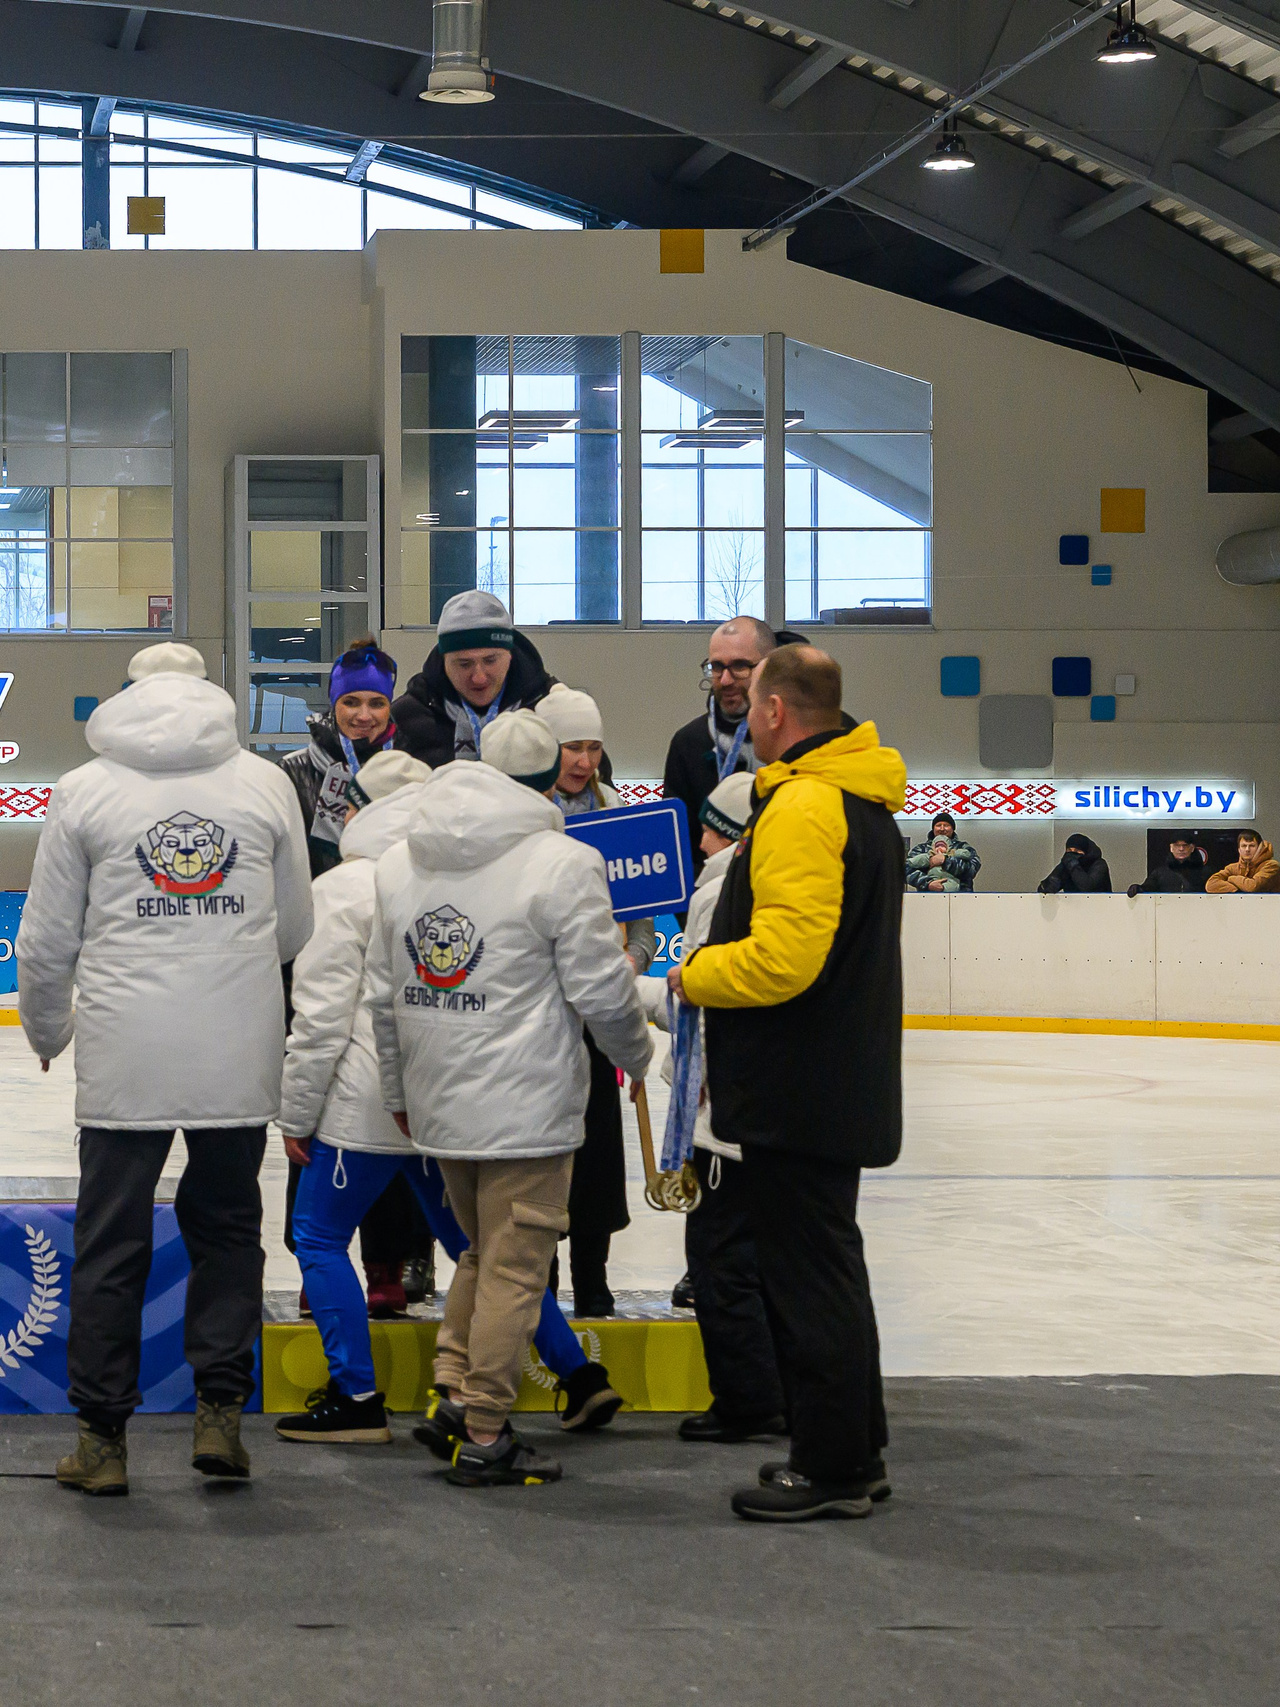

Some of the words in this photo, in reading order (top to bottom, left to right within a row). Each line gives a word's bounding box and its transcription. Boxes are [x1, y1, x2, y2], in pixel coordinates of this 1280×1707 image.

[1074, 785, 1237, 813] silichy.by
[607, 852, 668, 882] ные
[136, 897, 192, 917] БЕЛЫЕ
[196, 895, 245, 915] ТИГРЫ
[404, 985, 440, 1008] БЕЛЫЕ
[442, 990, 486, 1012] ТИГРЫ
